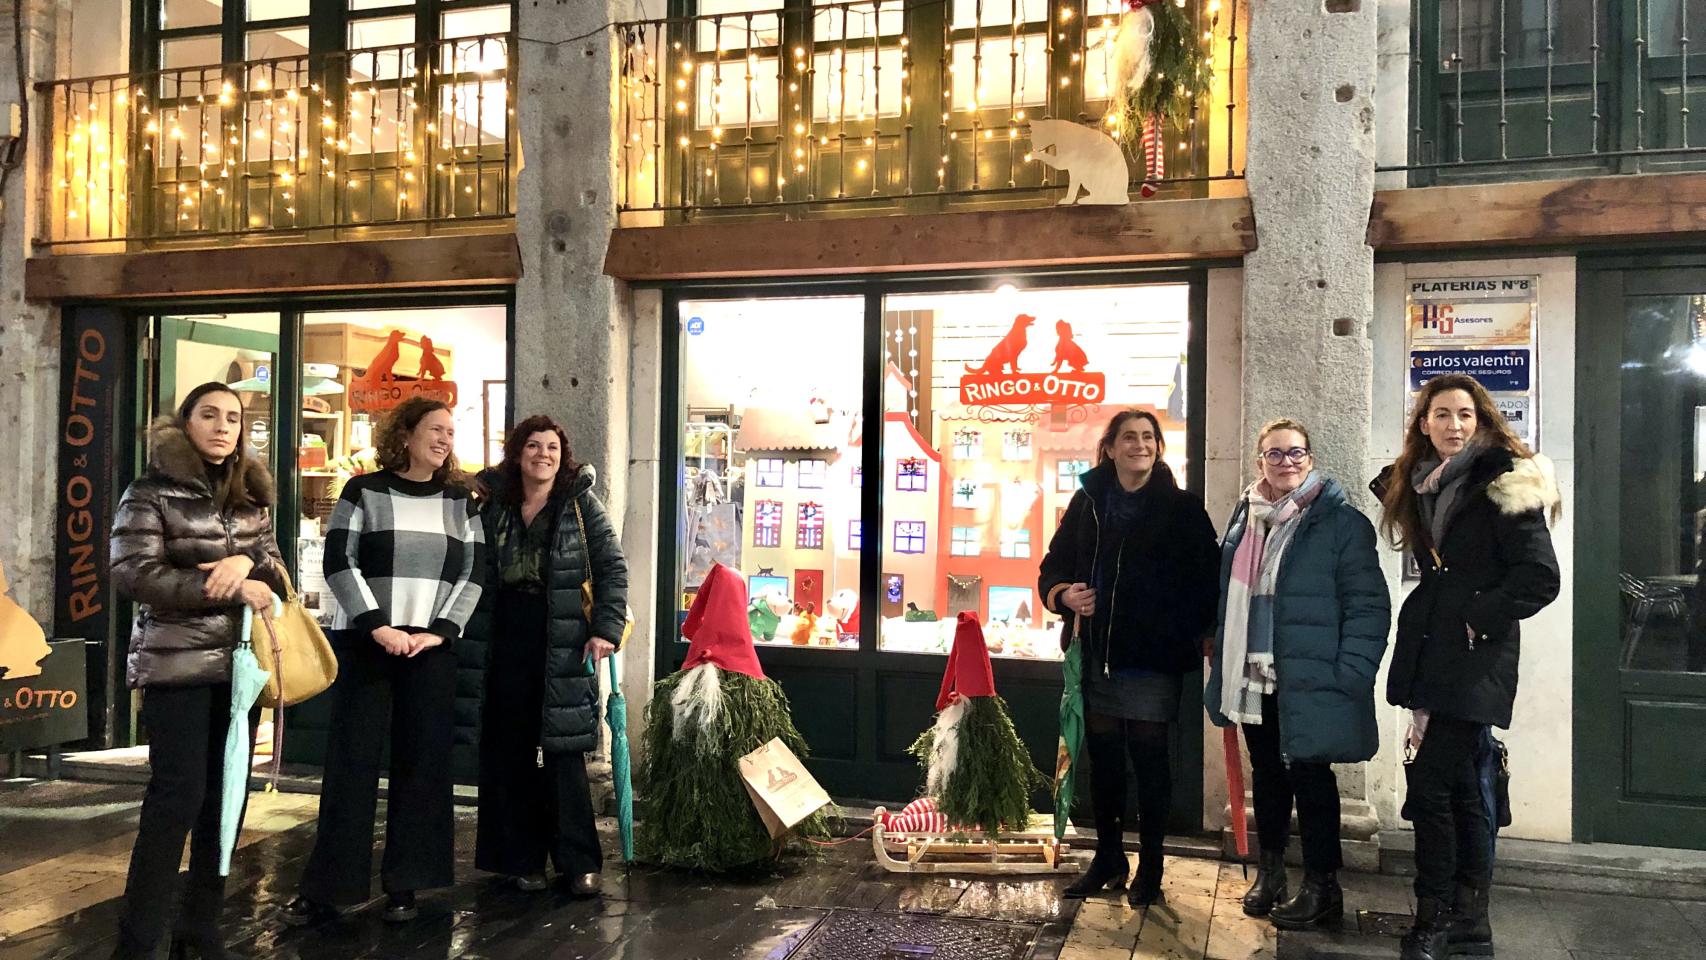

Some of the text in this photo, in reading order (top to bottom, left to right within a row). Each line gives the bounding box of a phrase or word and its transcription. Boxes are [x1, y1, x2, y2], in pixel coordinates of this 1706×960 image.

[1411, 281, 1497, 292] PLATERIAS
[965, 375, 1100, 402] RINGO & OTTO
[65, 328, 105, 622] RINGO & OTTO
[4, 687, 77, 709] & OTTO
